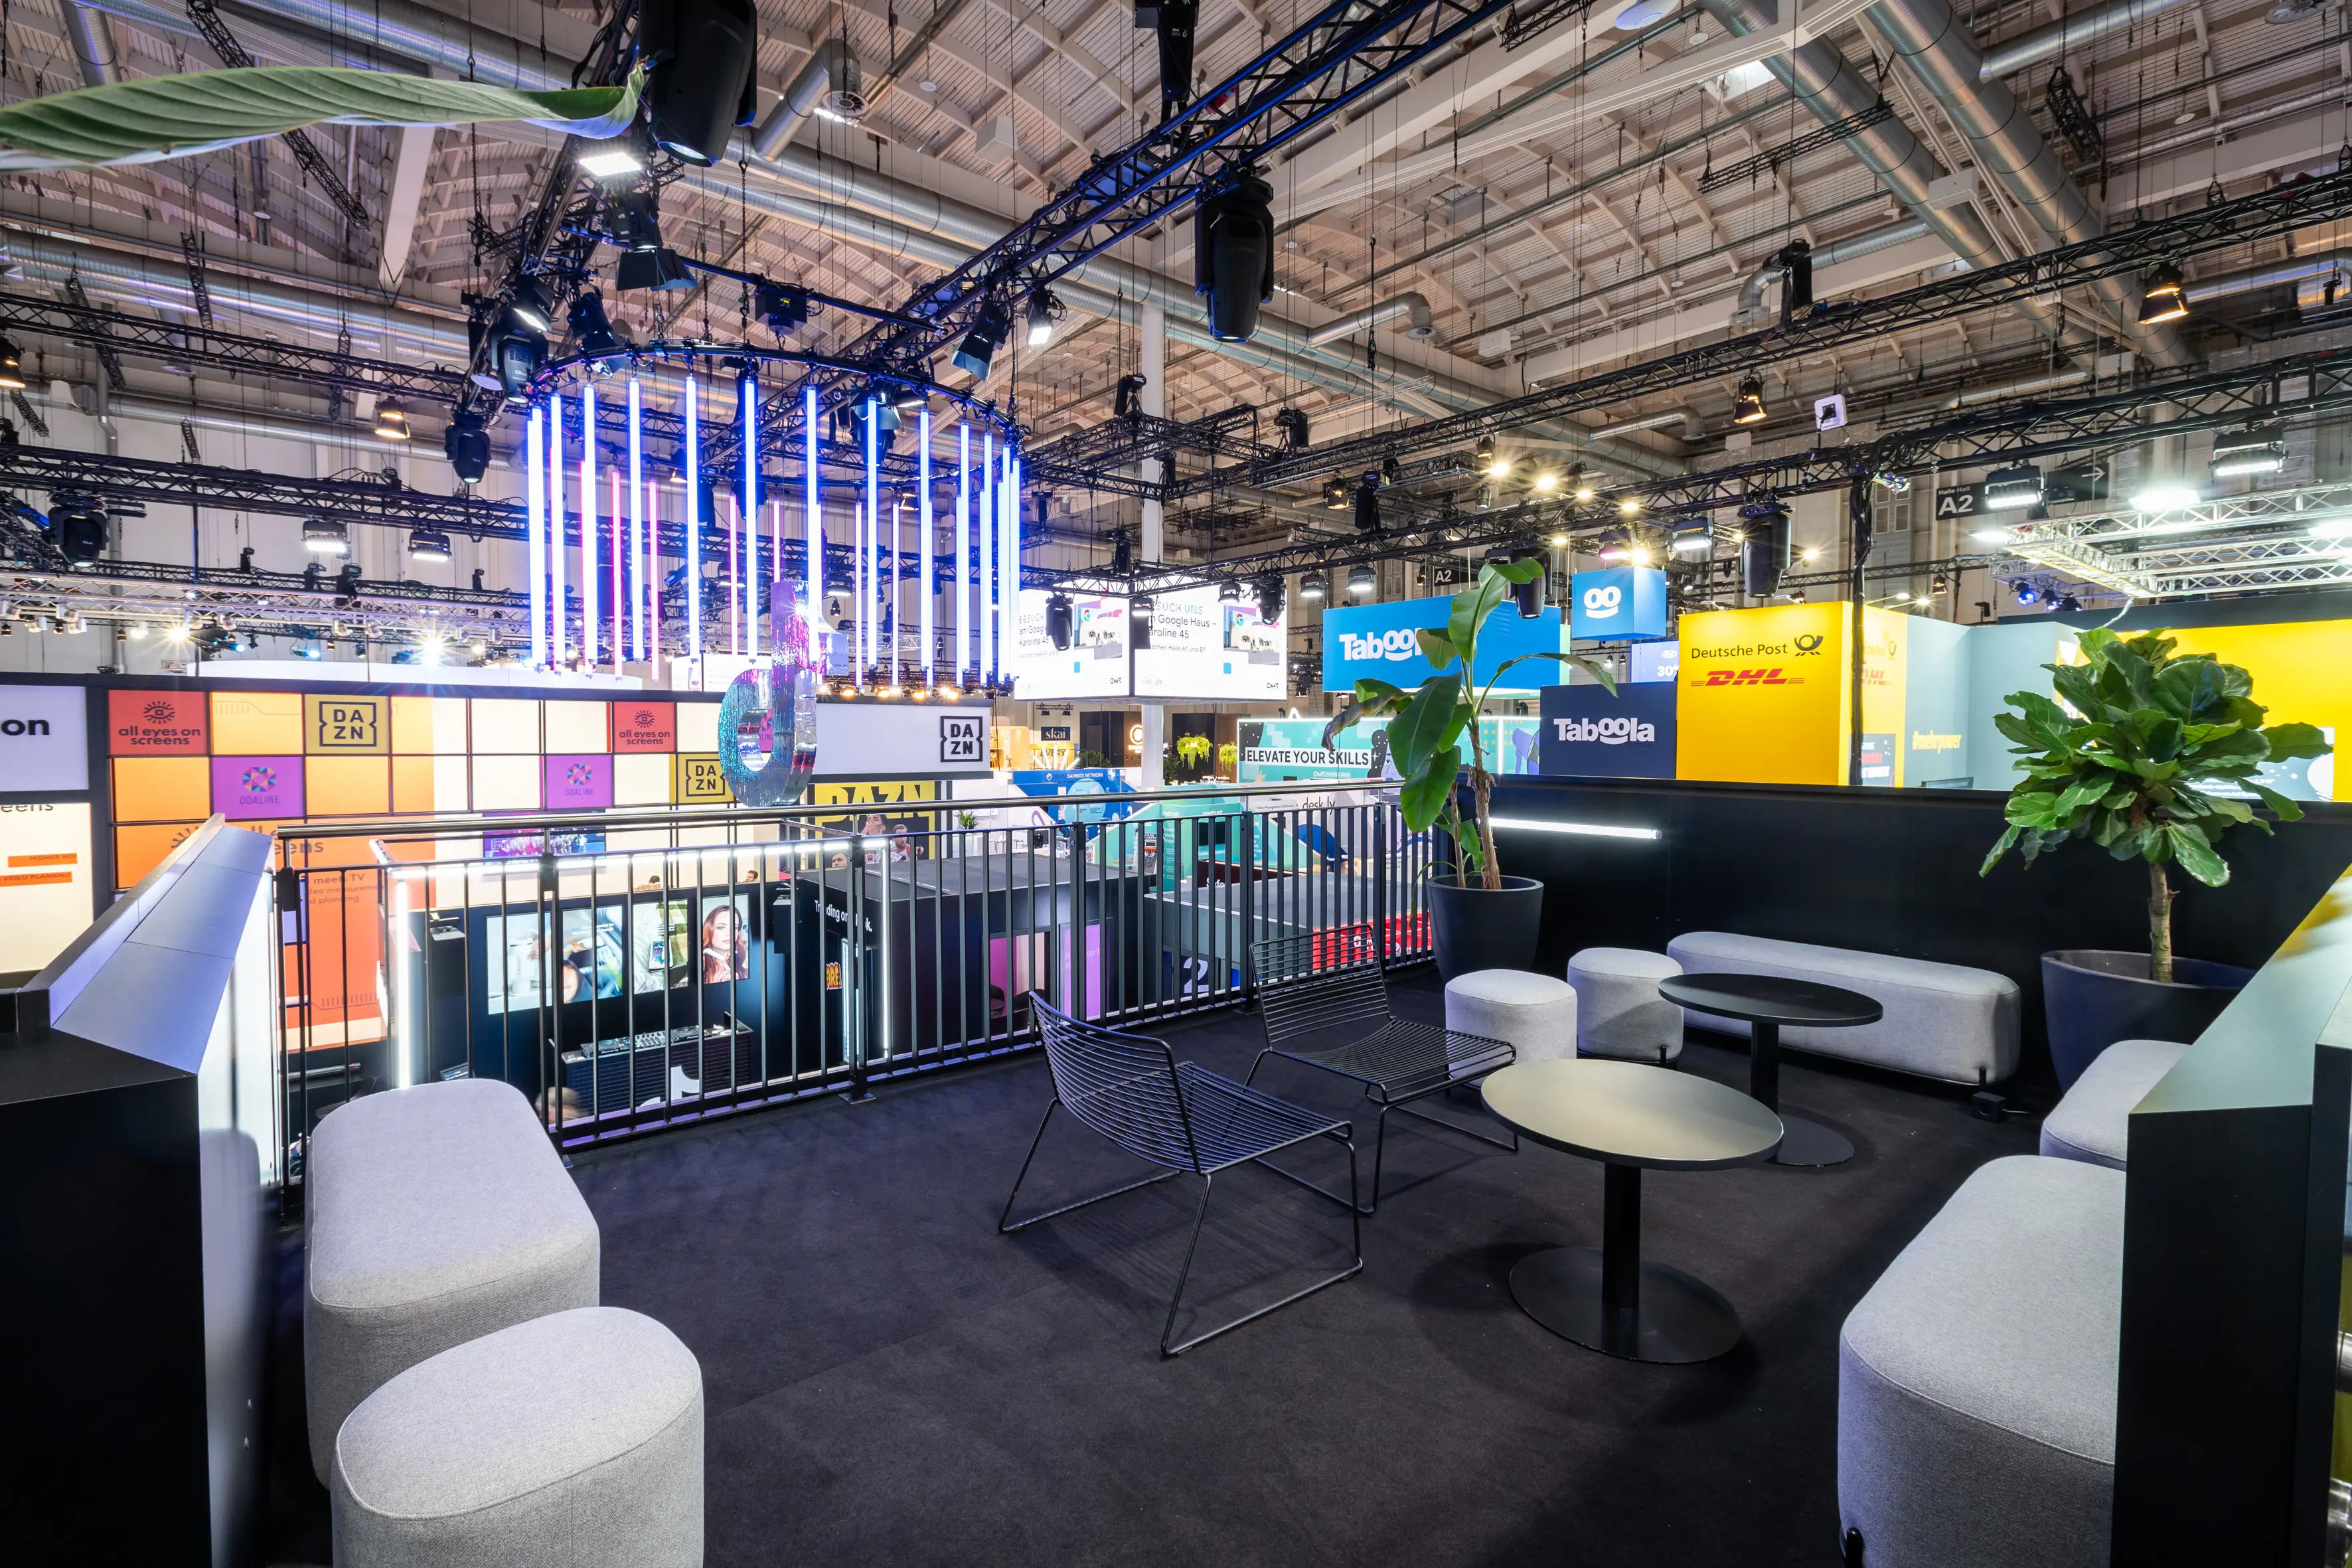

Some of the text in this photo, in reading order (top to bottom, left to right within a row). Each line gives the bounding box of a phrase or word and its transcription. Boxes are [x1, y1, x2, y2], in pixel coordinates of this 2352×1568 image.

[1938, 495, 1973, 516] A2
[1435, 570, 1452, 584] A2
[1158, 614, 1188, 627] Google
[1190, 616, 1210, 627] Haus
[1028, 625, 1044, 634] Goog
[1149, 628, 1190, 639] aroline 45
[1019, 637, 1041, 647] Karoline
[1338, 627, 1426, 661] Tabool
[1691, 643, 1788, 659] Deutsche Post
[1142, 677, 1163, 686] Gogle
[1705, 668, 1788, 686] DHL
[333, 709, 364, 723] DA
[1, 719, 50, 736] on
[118, 726, 201, 738] all eyes on
[333, 726, 364, 740] ZN
[951, 724, 974, 738] DA
[1553, 718, 1655, 743] Taboola
[130, 737, 190, 745] screens
[619, 730, 632, 738] all
[634, 731, 656, 740] eyes
[951, 740, 973, 755] ZN
[1912, 730, 1962, 754] #mehrpower
[1247, 750, 1369, 765] ELEVATE YOUR SKILLS
[695, 765, 716, 777] DA
[695, 779, 716, 790] ZN
[565, 788, 595, 797] ODALINE
[239, 795, 280, 805] ODALINE
[351, 873, 365, 882] TV
